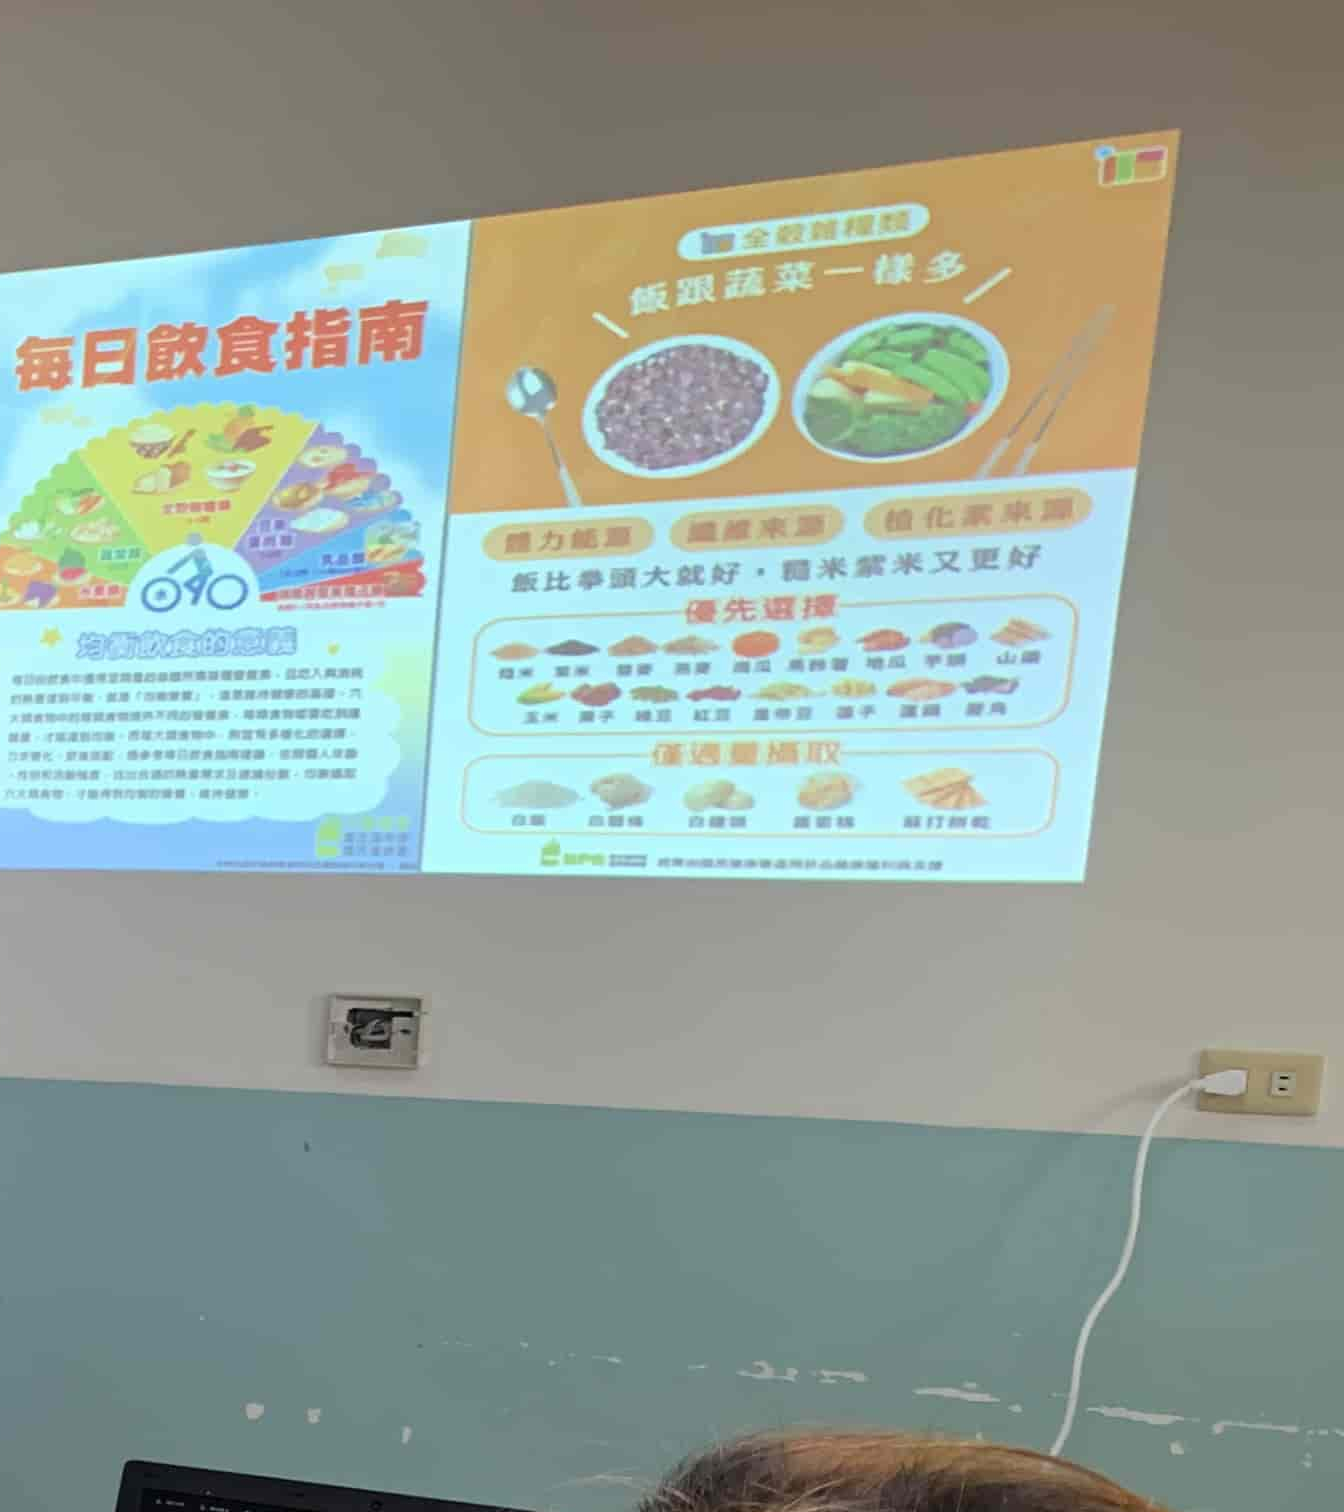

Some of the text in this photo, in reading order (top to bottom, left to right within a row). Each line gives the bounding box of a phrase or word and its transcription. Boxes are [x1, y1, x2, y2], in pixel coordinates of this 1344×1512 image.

[629, 249, 968, 316] 飯跟蔬菜一樣多
[15, 299, 428, 391] 每日飲食指南
[686, 595, 835, 622] 優先選擇
[76, 626, 298, 661] 均衡飲食的意義
